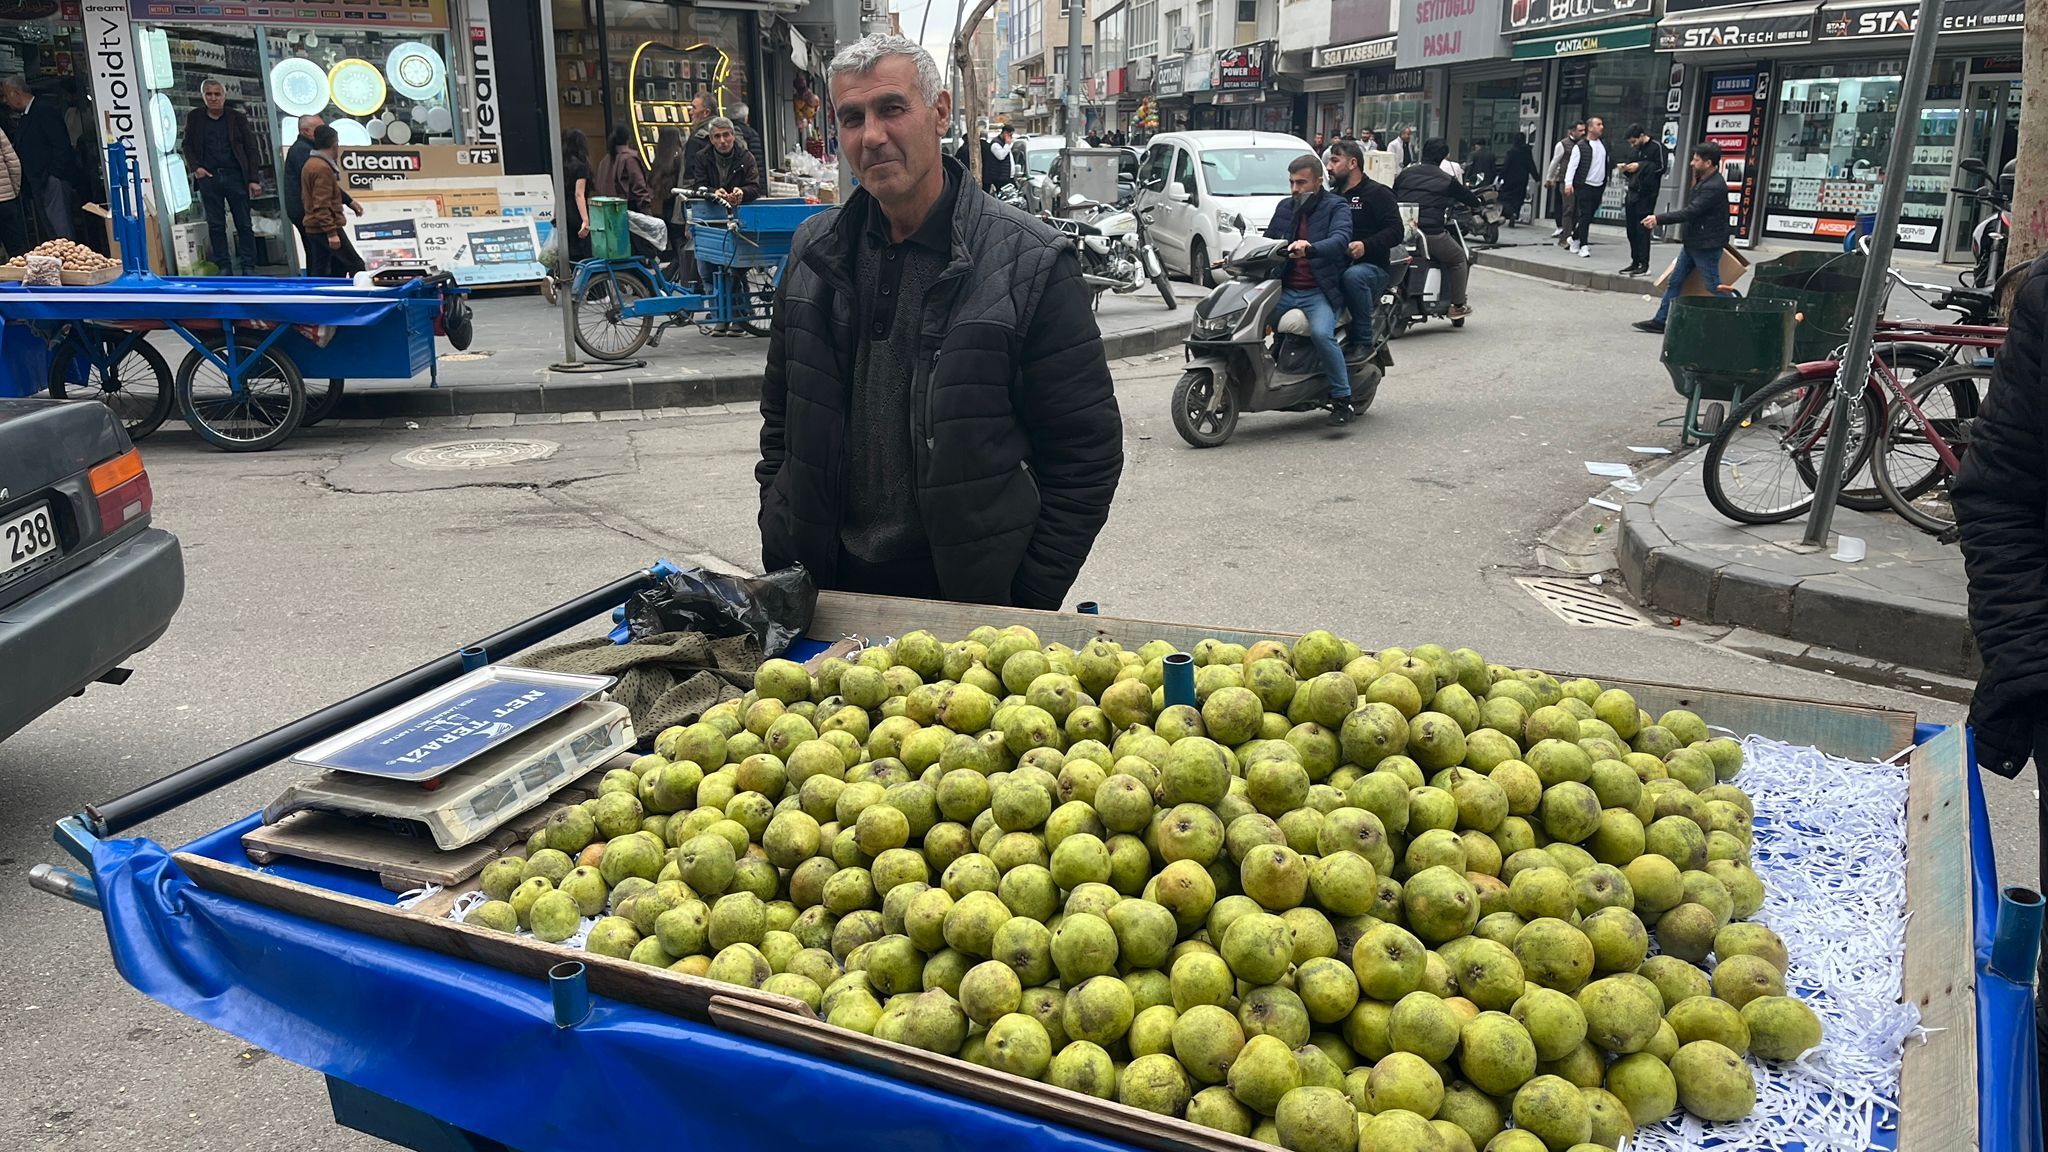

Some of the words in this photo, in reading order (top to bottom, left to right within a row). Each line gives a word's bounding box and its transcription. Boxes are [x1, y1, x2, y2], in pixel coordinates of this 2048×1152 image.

[1423, 31, 1462, 57] PASAJI
[1324, 52, 1342, 65] SGA
[1343, 42, 1394, 62] AKSESUAR
[473, 40, 497, 145] ream
[1717, 79, 1750, 89] SAMSUNG
[1721, 119, 1742, 128] iPhone
[1718, 139, 1742, 147] HUAWEI
[343, 152, 412, 170] dream
[421, 221, 449, 229] dream
[1779, 219, 1813, 230] TELEFON
[6, 512, 51, 563] 238
[492, 689, 546, 718] NET
